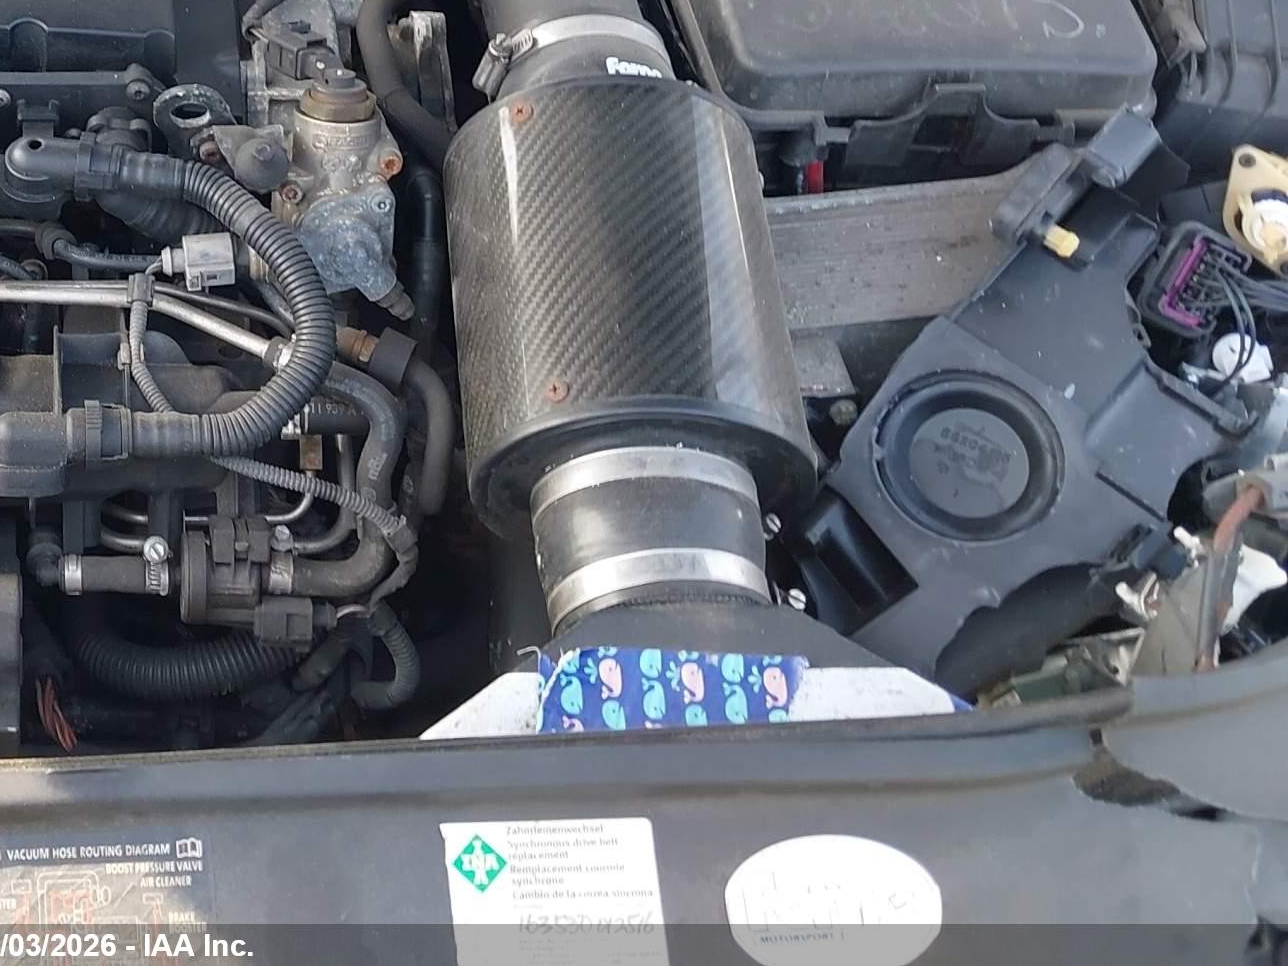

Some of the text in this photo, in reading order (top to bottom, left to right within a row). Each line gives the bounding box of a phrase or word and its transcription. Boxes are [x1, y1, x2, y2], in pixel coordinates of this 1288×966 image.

[7, 847, 50, 861] VACUUM
[52, 846, 78, 859] HOSE
[79, 845, 123, 858] ROUTING
[125, 843, 171, 857] DIAGRAM
[105, 860, 204, 875] BOOST PRESSURE VALVE
[140, 875, 193, 888] AIR CLEANER
